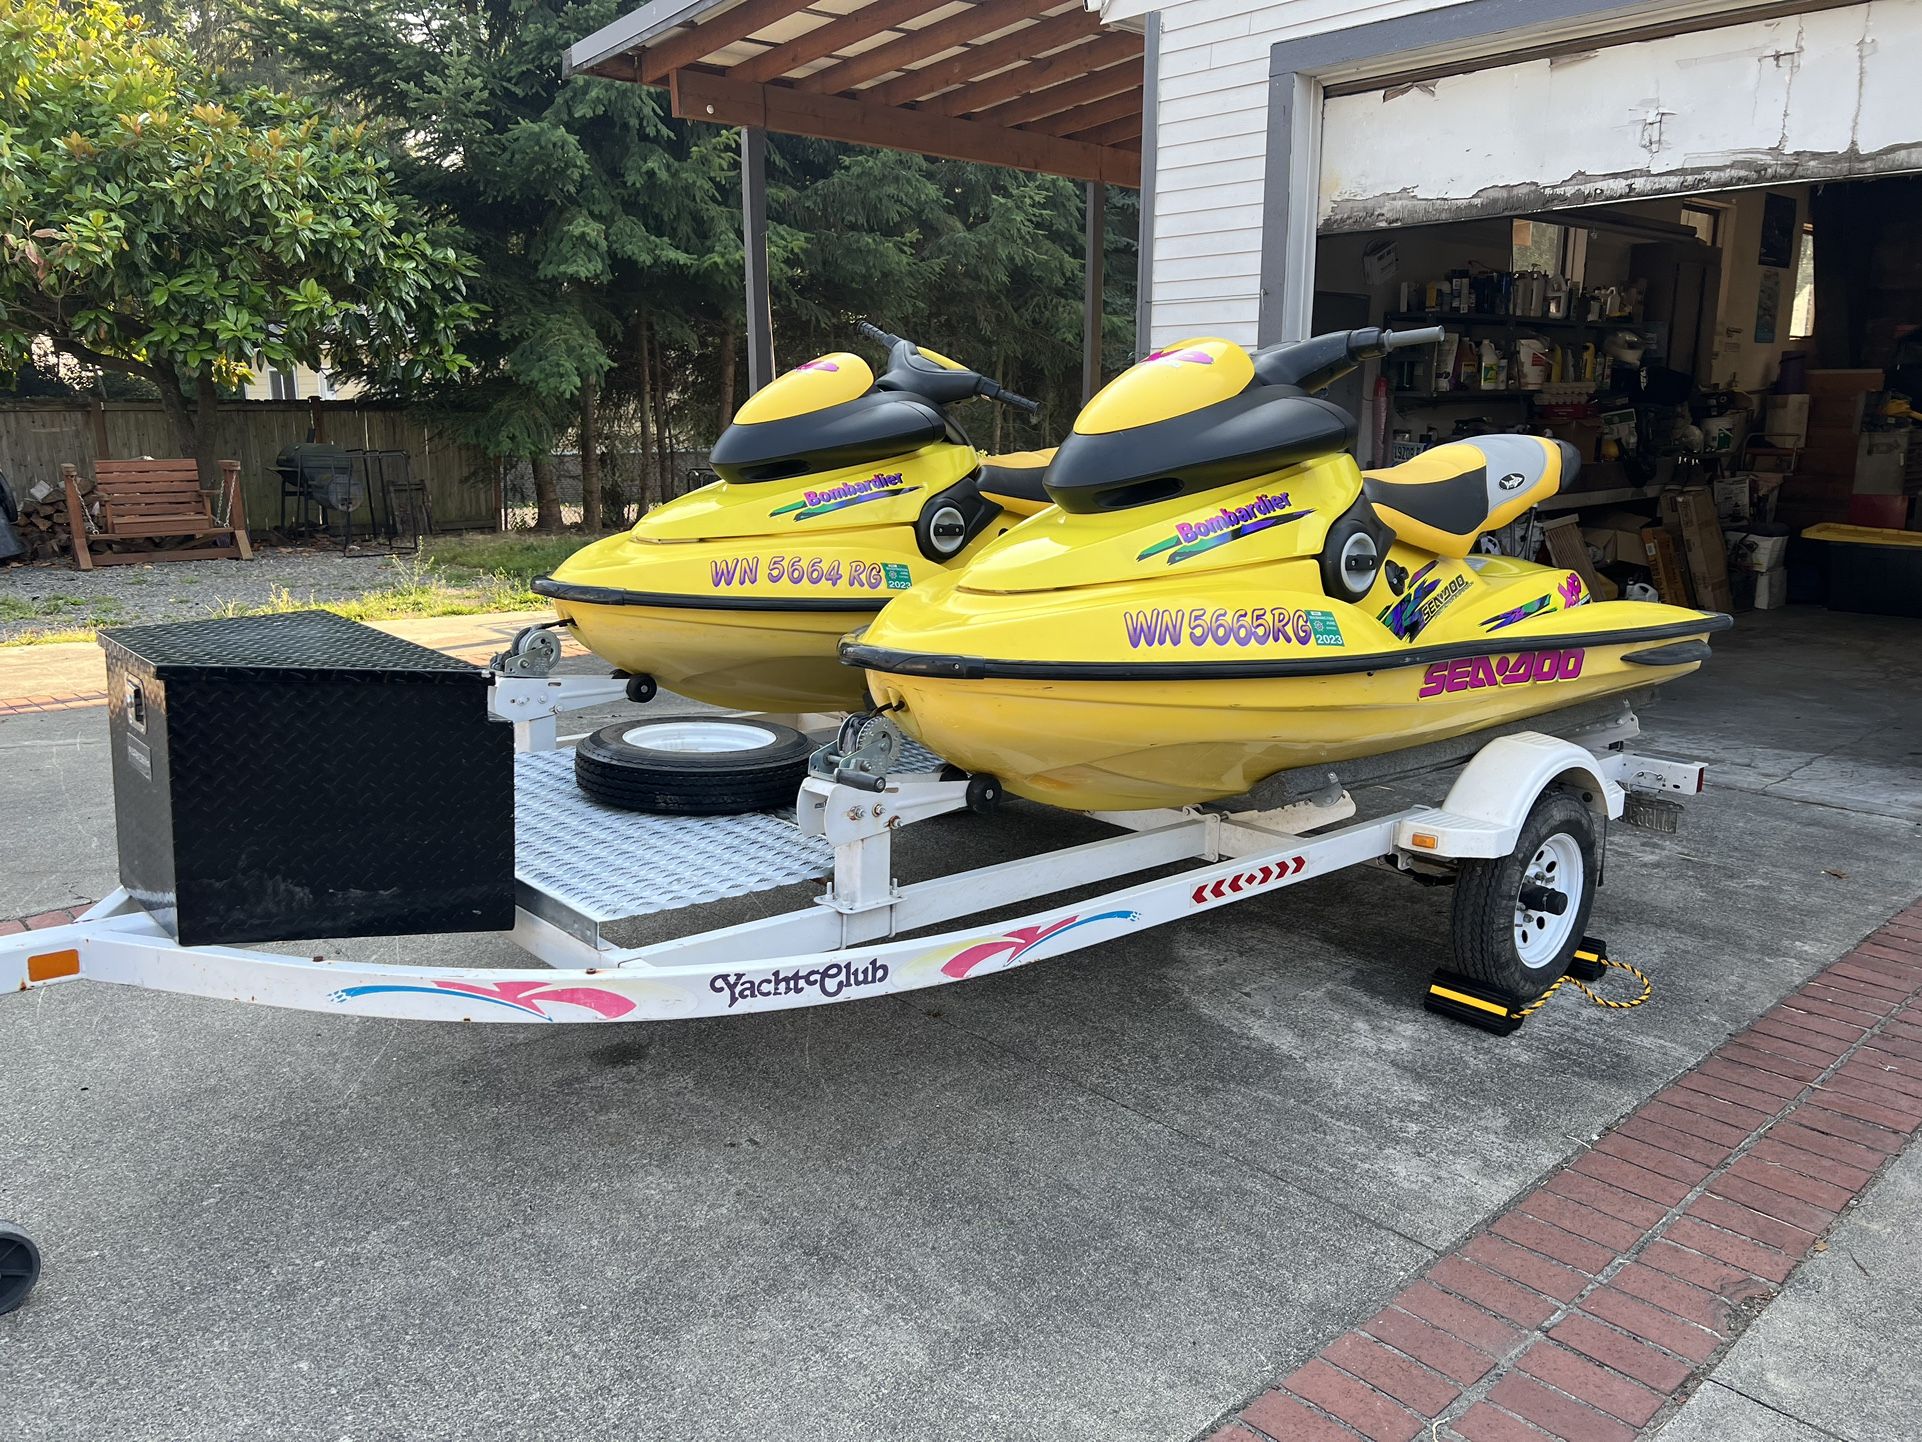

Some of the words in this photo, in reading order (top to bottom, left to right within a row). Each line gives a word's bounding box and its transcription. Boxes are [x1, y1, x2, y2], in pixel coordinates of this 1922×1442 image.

[805, 472, 903, 506] Bombardier
[1175, 493, 1290, 542] Bombardier
[710, 556, 759, 588] WN
[767, 555, 842, 586] 5664
[848, 560, 883, 590] RG
[888, 580, 912, 589] 2023
[1124, 608, 1183, 648] WN
[1316, 634, 1343, 645] 2023
